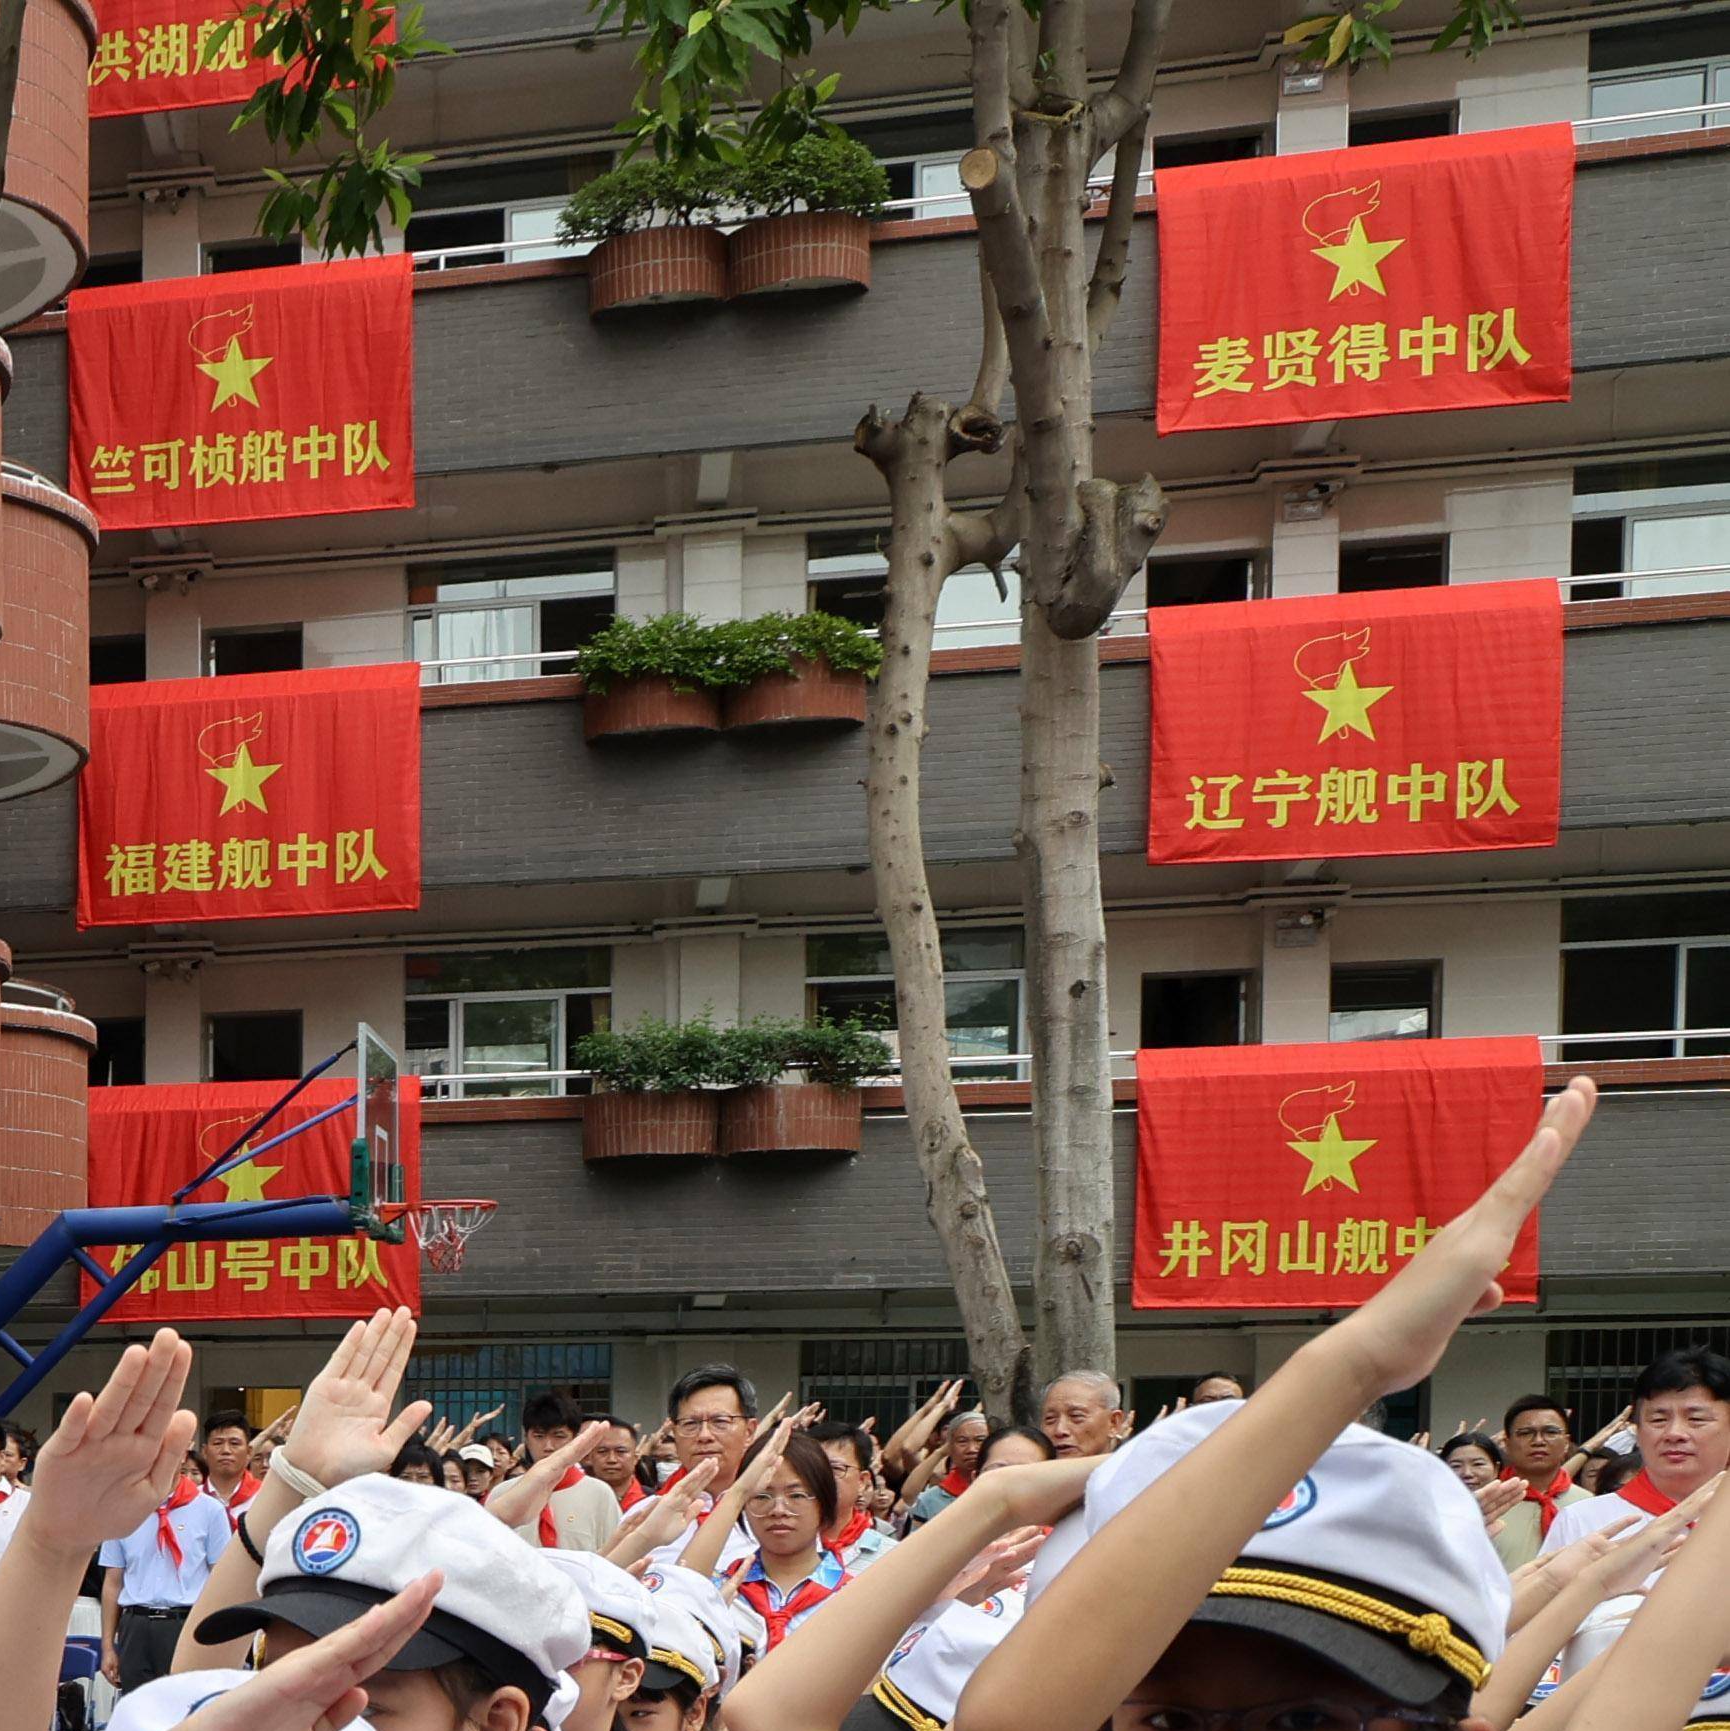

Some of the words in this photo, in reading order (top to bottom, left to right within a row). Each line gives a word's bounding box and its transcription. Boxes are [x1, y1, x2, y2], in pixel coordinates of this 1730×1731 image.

[1193, 307, 1533, 398] 麦贤得中队
[90, 420, 391, 494] 竺可桢船中队
[1184, 758, 1521, 831] 辽宁舰中队
[104, 829, 389, 897] 福建舰中队
[1159, 1217, 1510, 1278] 井冈山舰中
